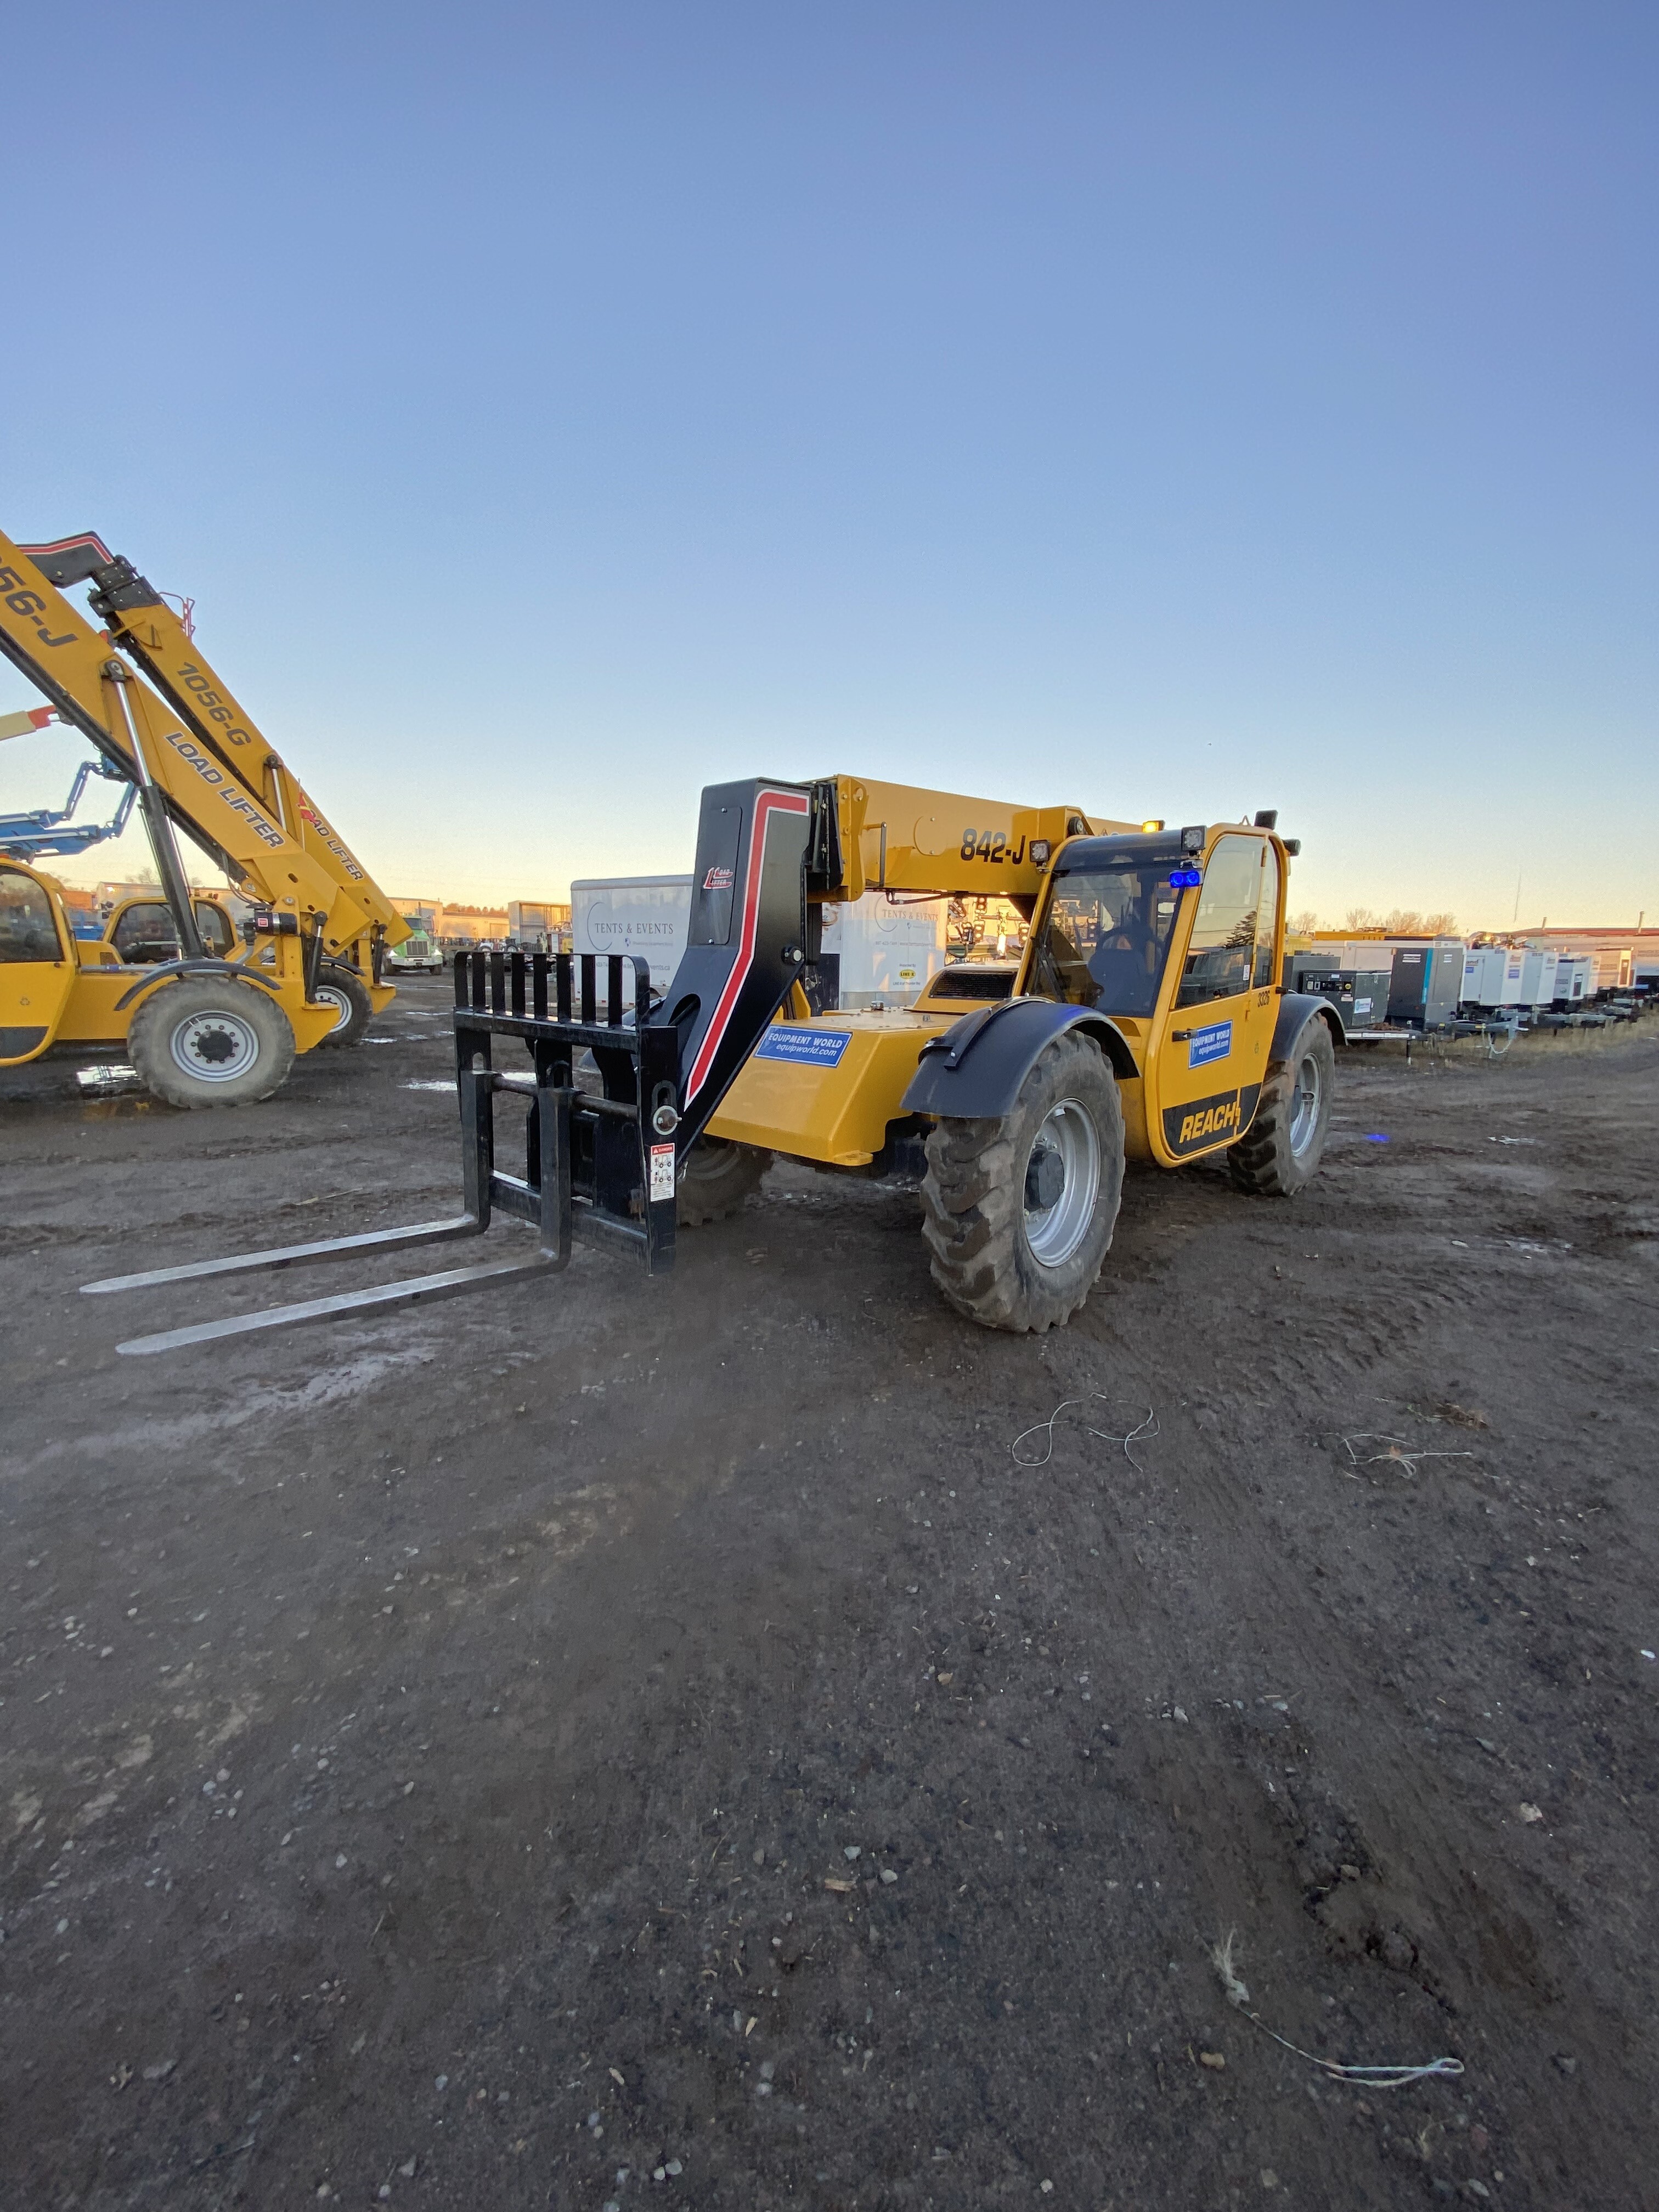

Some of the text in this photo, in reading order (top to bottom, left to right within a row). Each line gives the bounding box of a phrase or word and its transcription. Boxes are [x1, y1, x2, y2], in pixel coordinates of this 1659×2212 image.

[0, 557, 78, 647] 56-J
[177, 662, 251, 746] 1056-G
[164, 731, 286, 849] LOAD LIFTER
[325, 838, 364, 881] LIFTER
[961, 828, 1026, 865] 842-J
[595, 923, 674, 934] TENTS & EVENTS
[883, 909, 906, 919] TENTS
[916, 912, 938, 922] EVENTS
[768, 1033, 843, 1048] EQUIPMENT WORLD
[776, 1043, 837, 1057] equipworld.com
[1192, 1029, 1230, 1048] EQUIPMENT WORLD
[1179, 1101, 1237, 1144] REACH
